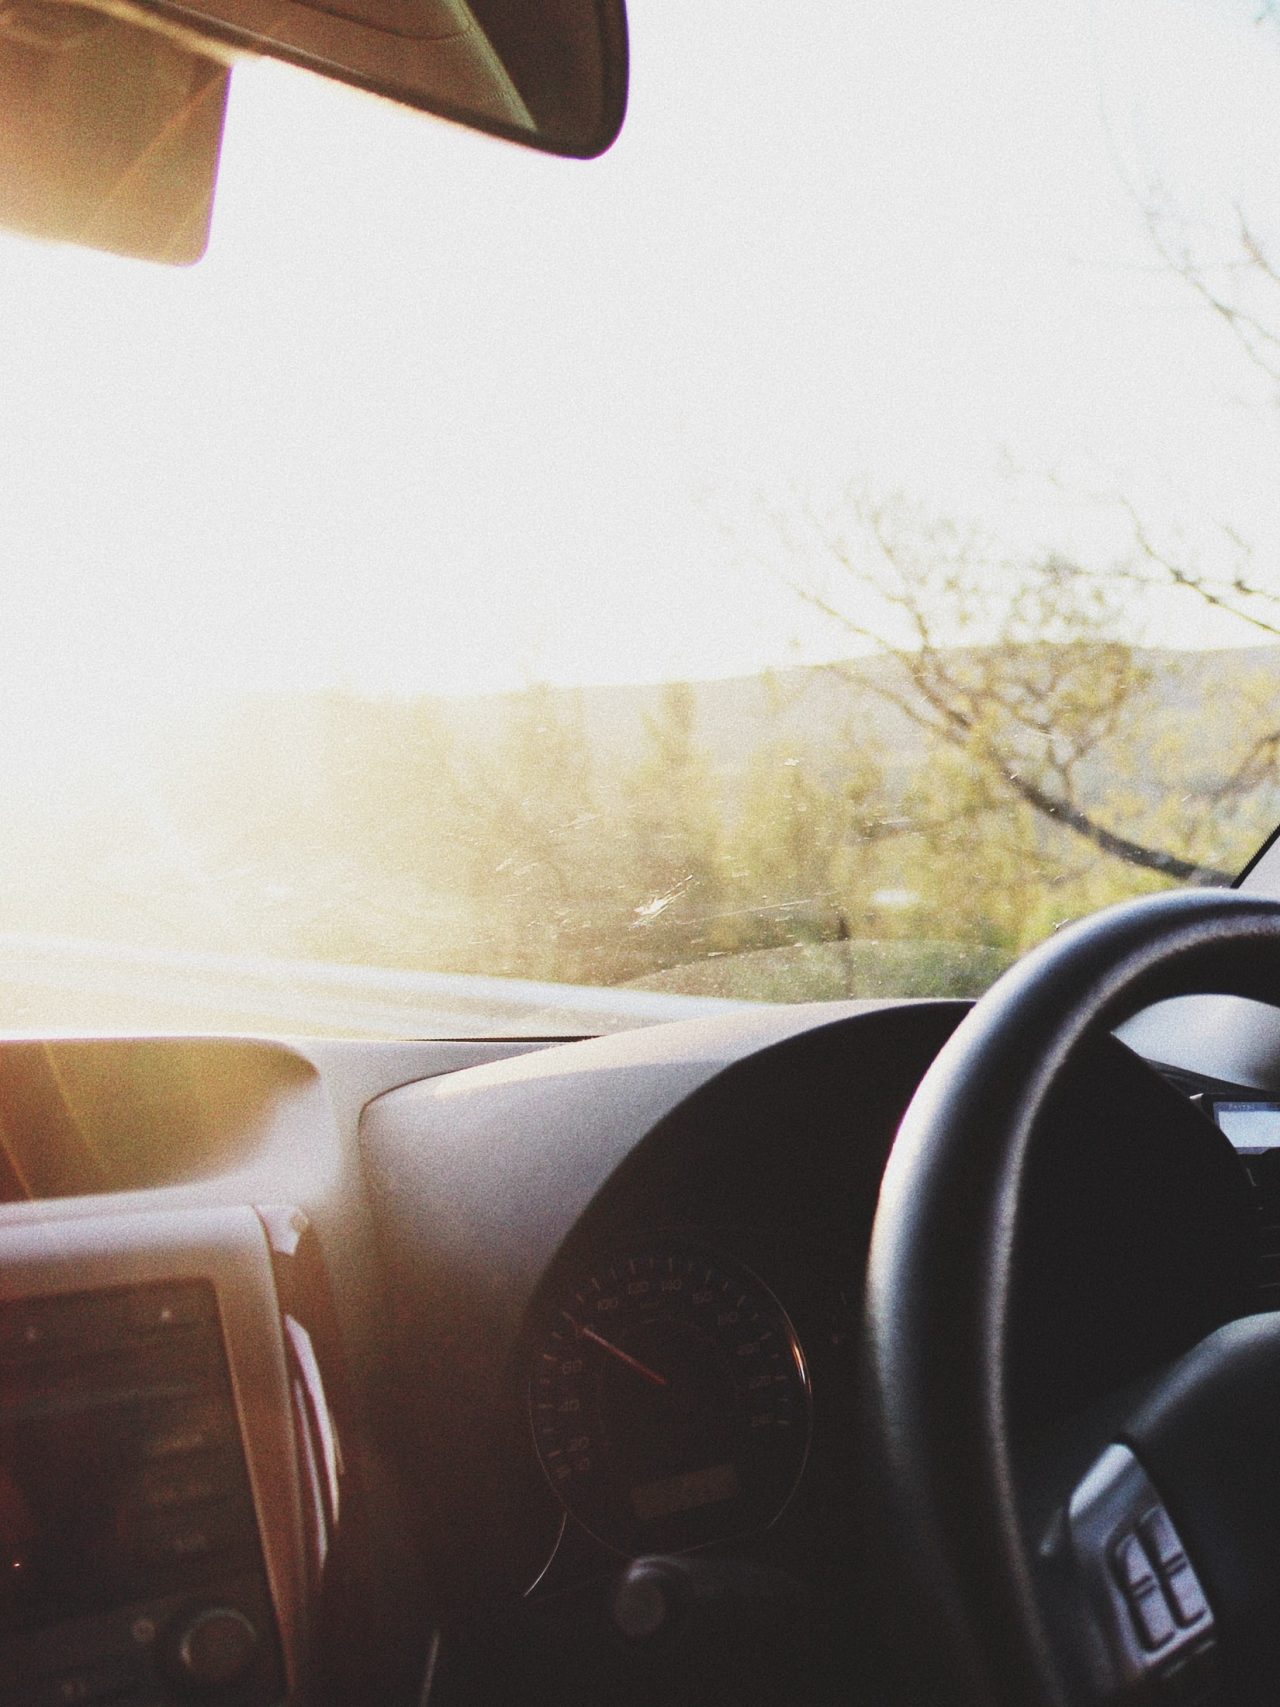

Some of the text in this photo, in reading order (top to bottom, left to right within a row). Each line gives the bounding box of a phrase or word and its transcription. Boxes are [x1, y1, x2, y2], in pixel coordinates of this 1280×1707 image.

[561, 1358, 583, 1375] 60
[557, 1397, 581, 1413] 40
[566, 1435, 590, 1453] 20
